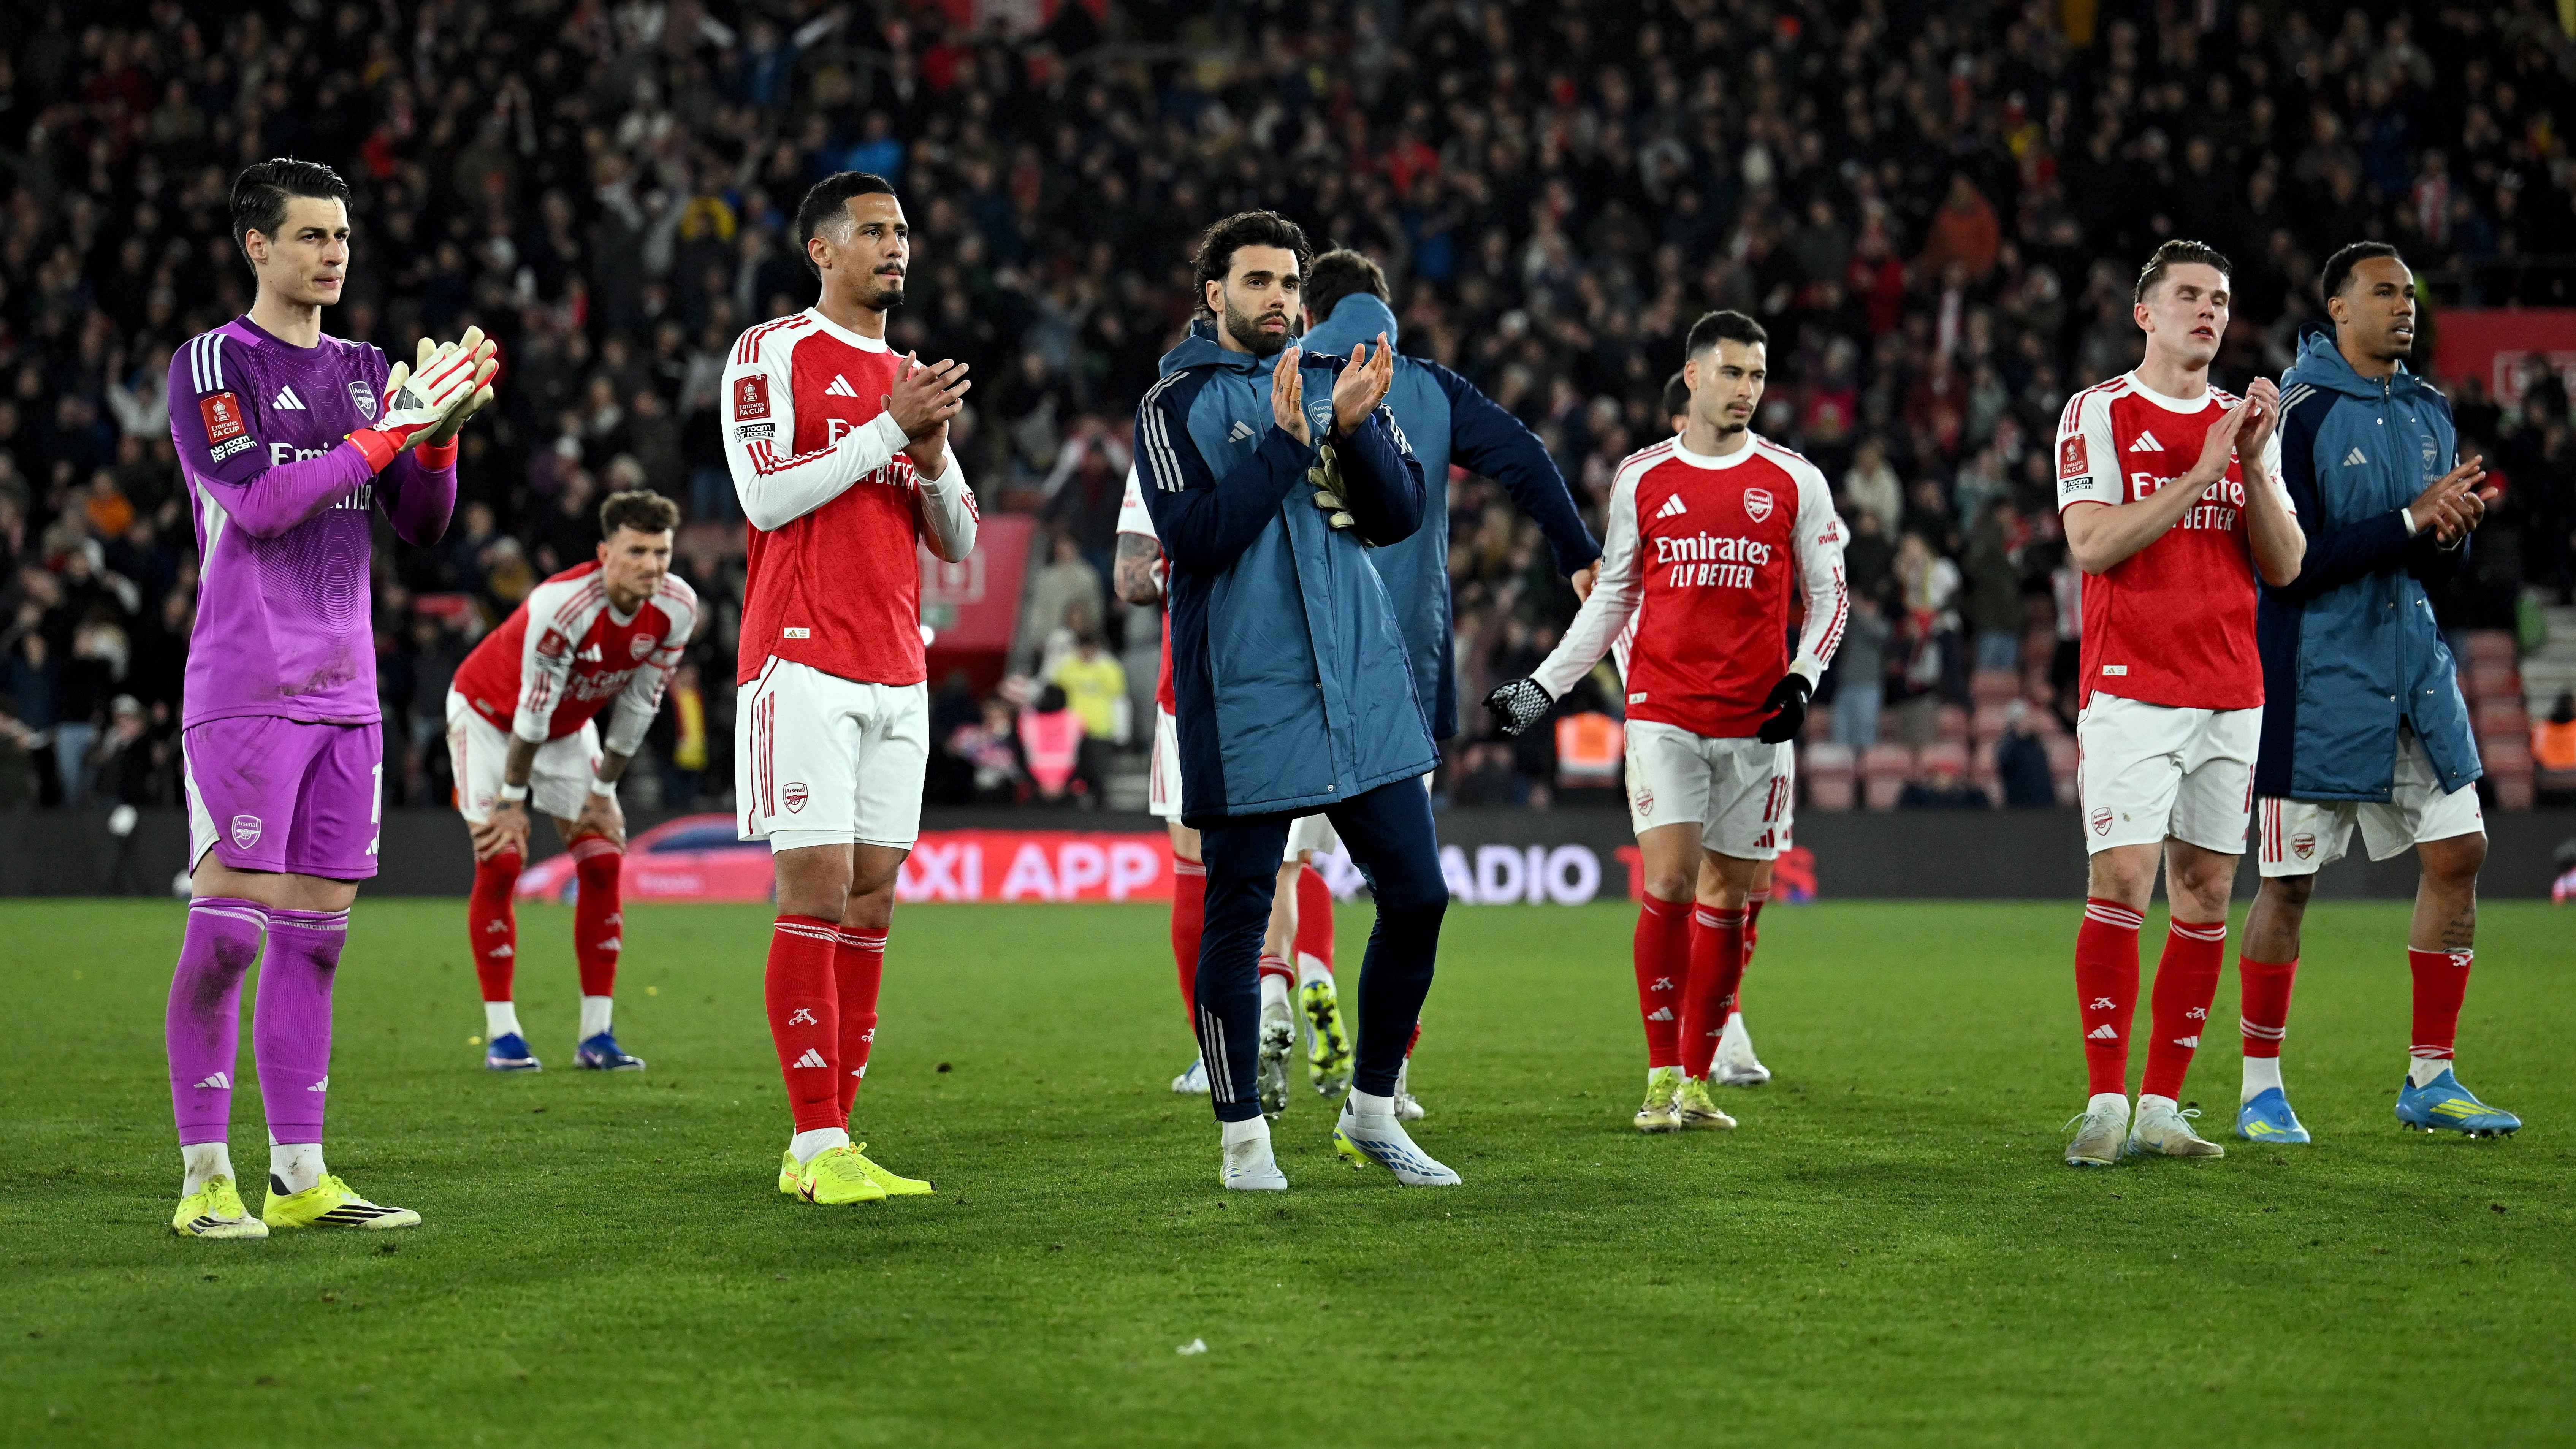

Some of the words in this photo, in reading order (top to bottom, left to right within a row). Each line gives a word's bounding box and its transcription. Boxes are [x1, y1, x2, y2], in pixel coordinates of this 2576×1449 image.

[211, 420, 238, 432] Emirates
[223, 426, 240, 434] CUP
[734, 426, 746, 435] No
[210, 445, 224, 456] No
[224, 435, 250, 449] room
[227, 440, 258, 456] racism
[2064, 460, 2083, 469] Emirates
[2072, 464, 2084, 473] CUP
[2067, 483, 2092, 493] racism
[2068, 478, 2089, 486] room
[1748, 493, 1768, 502] Arsenal
[2184, 505, 2236, 531] BETTER
[1818, 532, 1839, 546] RWA
[1653, 531, 1772, 566] Emirates
[1670, 564, 1695, 588] FLY
[1697, 563, 1754, 589] BETTER
[998, 843, 1160, 903] APP
[1438, 844, 1601, 906] ADIO
